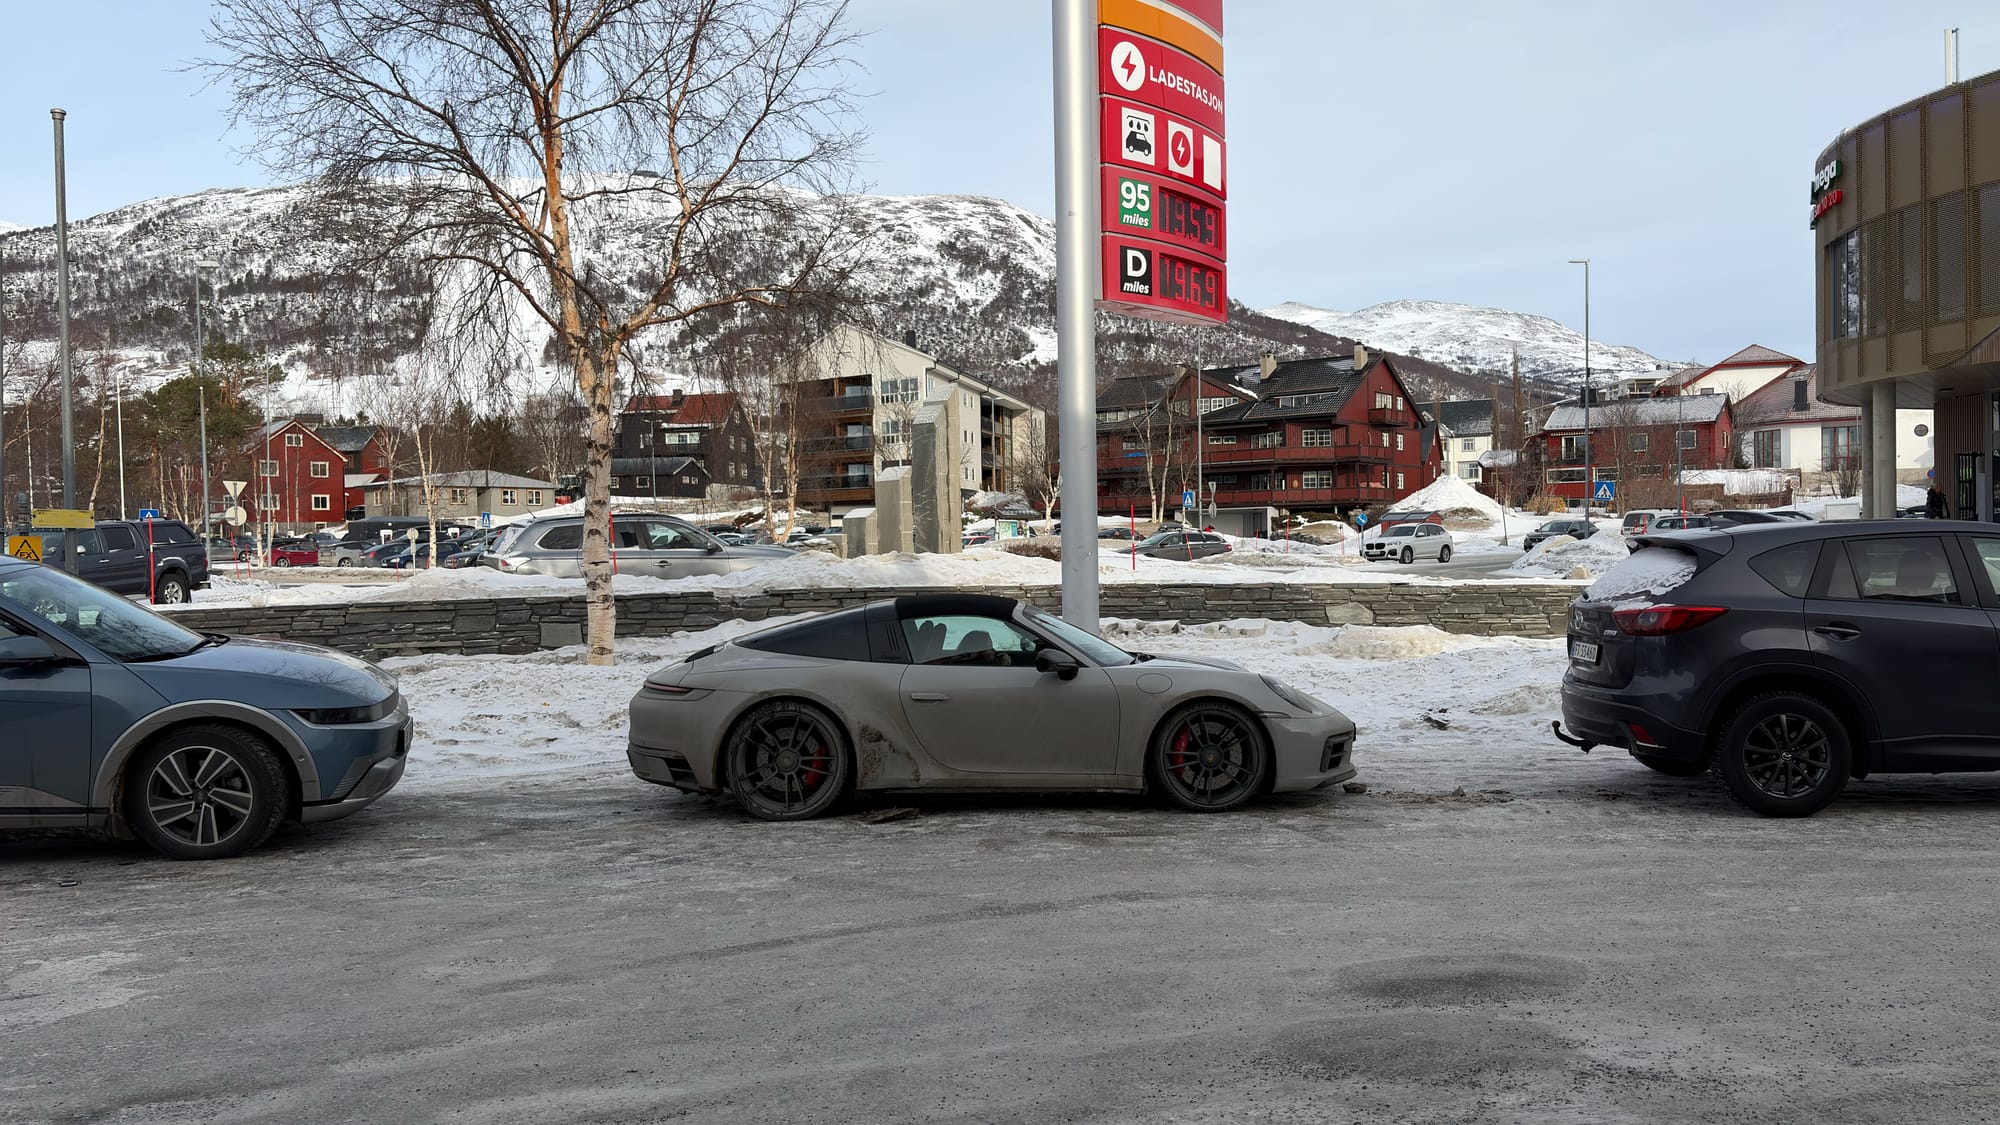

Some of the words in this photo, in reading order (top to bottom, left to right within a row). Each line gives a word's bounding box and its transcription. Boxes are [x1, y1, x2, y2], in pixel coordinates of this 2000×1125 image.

[1149, 65, 1223, 115] LADESTASJON
[1121, 181, 1150, 212] 95
[1122, 213, 1149, 227] miles
[1126, 249, 1147, 277] D
[1123, 281, 1149, 294] miles
